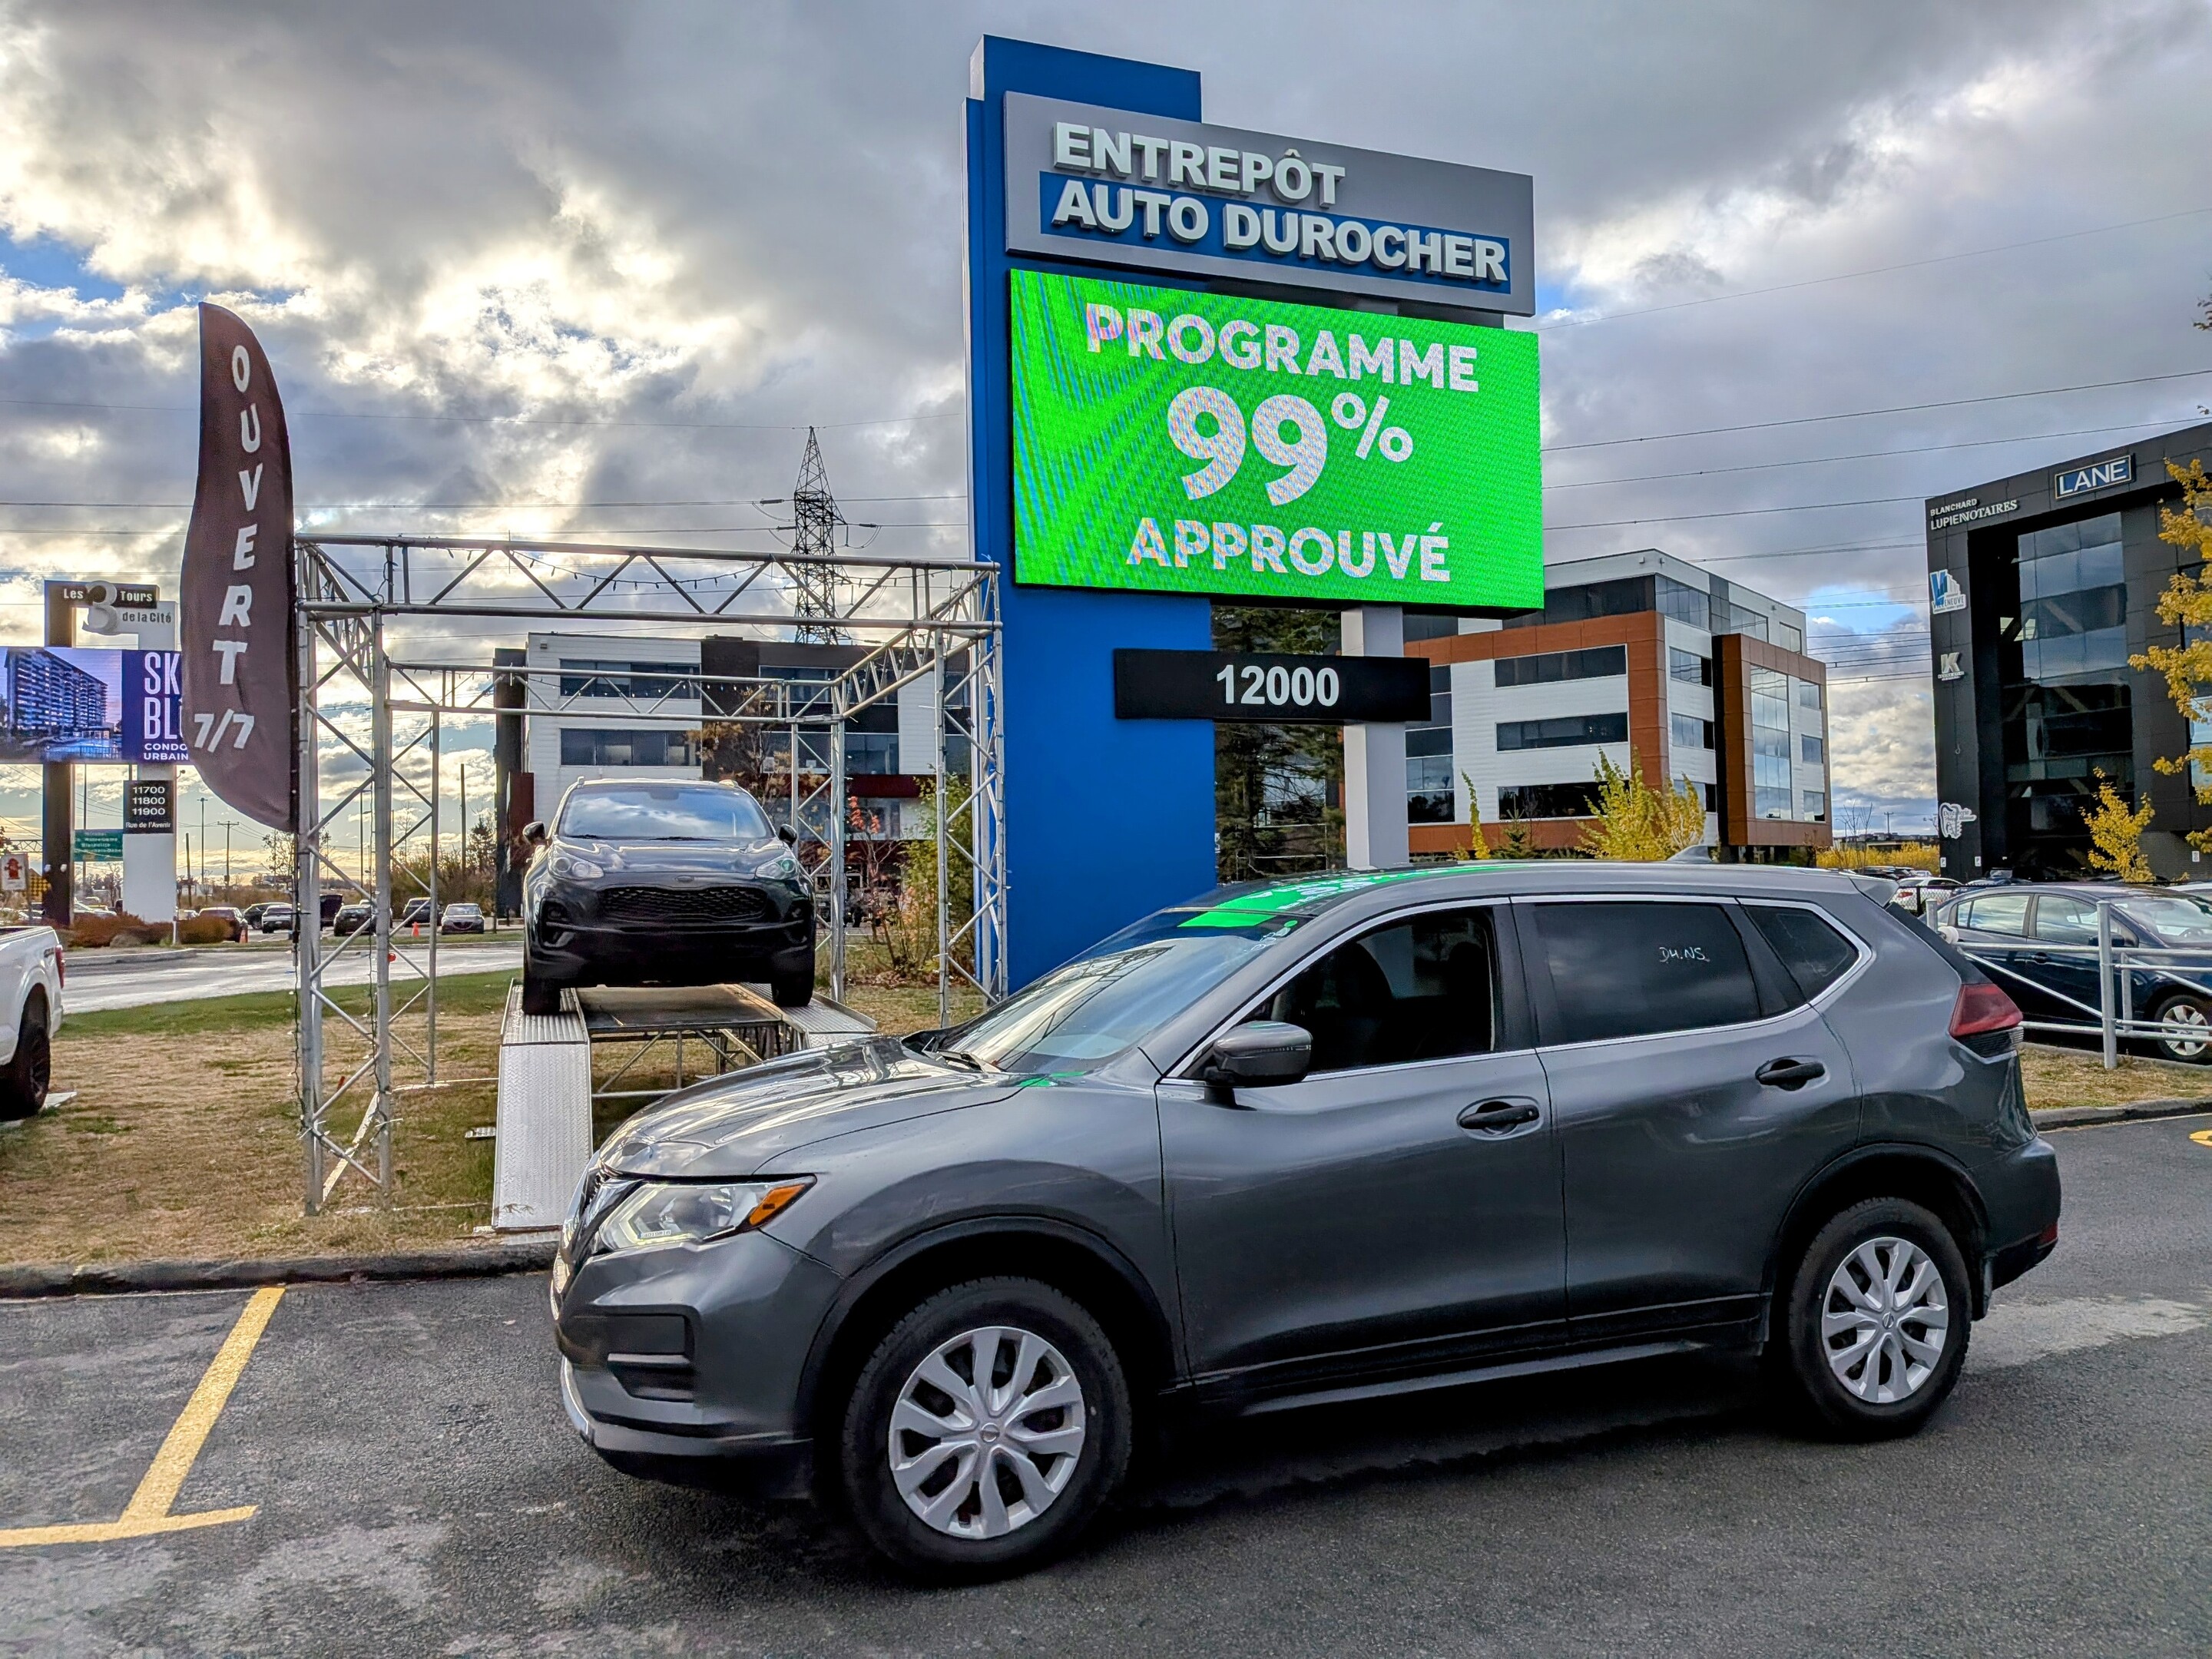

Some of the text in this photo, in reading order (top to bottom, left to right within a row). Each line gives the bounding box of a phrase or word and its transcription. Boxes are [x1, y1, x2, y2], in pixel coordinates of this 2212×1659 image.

[1054, 121, 1345, 207] ENTREPÔT
[1051, 179, 1508, 284] AUTO DUROCHER
[1086, 303, 1479, 392] PROGRAMME
[1167, 386, 1413, 506] 99%
[2059, 459, 2127, 495] LANE
[213, 345, 263, 684] OUVERT
[1930, 498, 1978, 517] BLANCHARD
[1126, 518, 1451, 582] APPROUVÉ
[63, 580, 153, 636] Les 3 Tours
[122, 611, 134, 621] de
[149, 611, 172, 623] Cité
[1217, 664, 1339, 707] 12000
[144, 697, 183, 740] BL
[194, 708, 254, 753] 7/7
[131, 807, 166, 816] 11900
[132, 786, 165, 794] 11700
[132, 796, 165, 805] 11800
